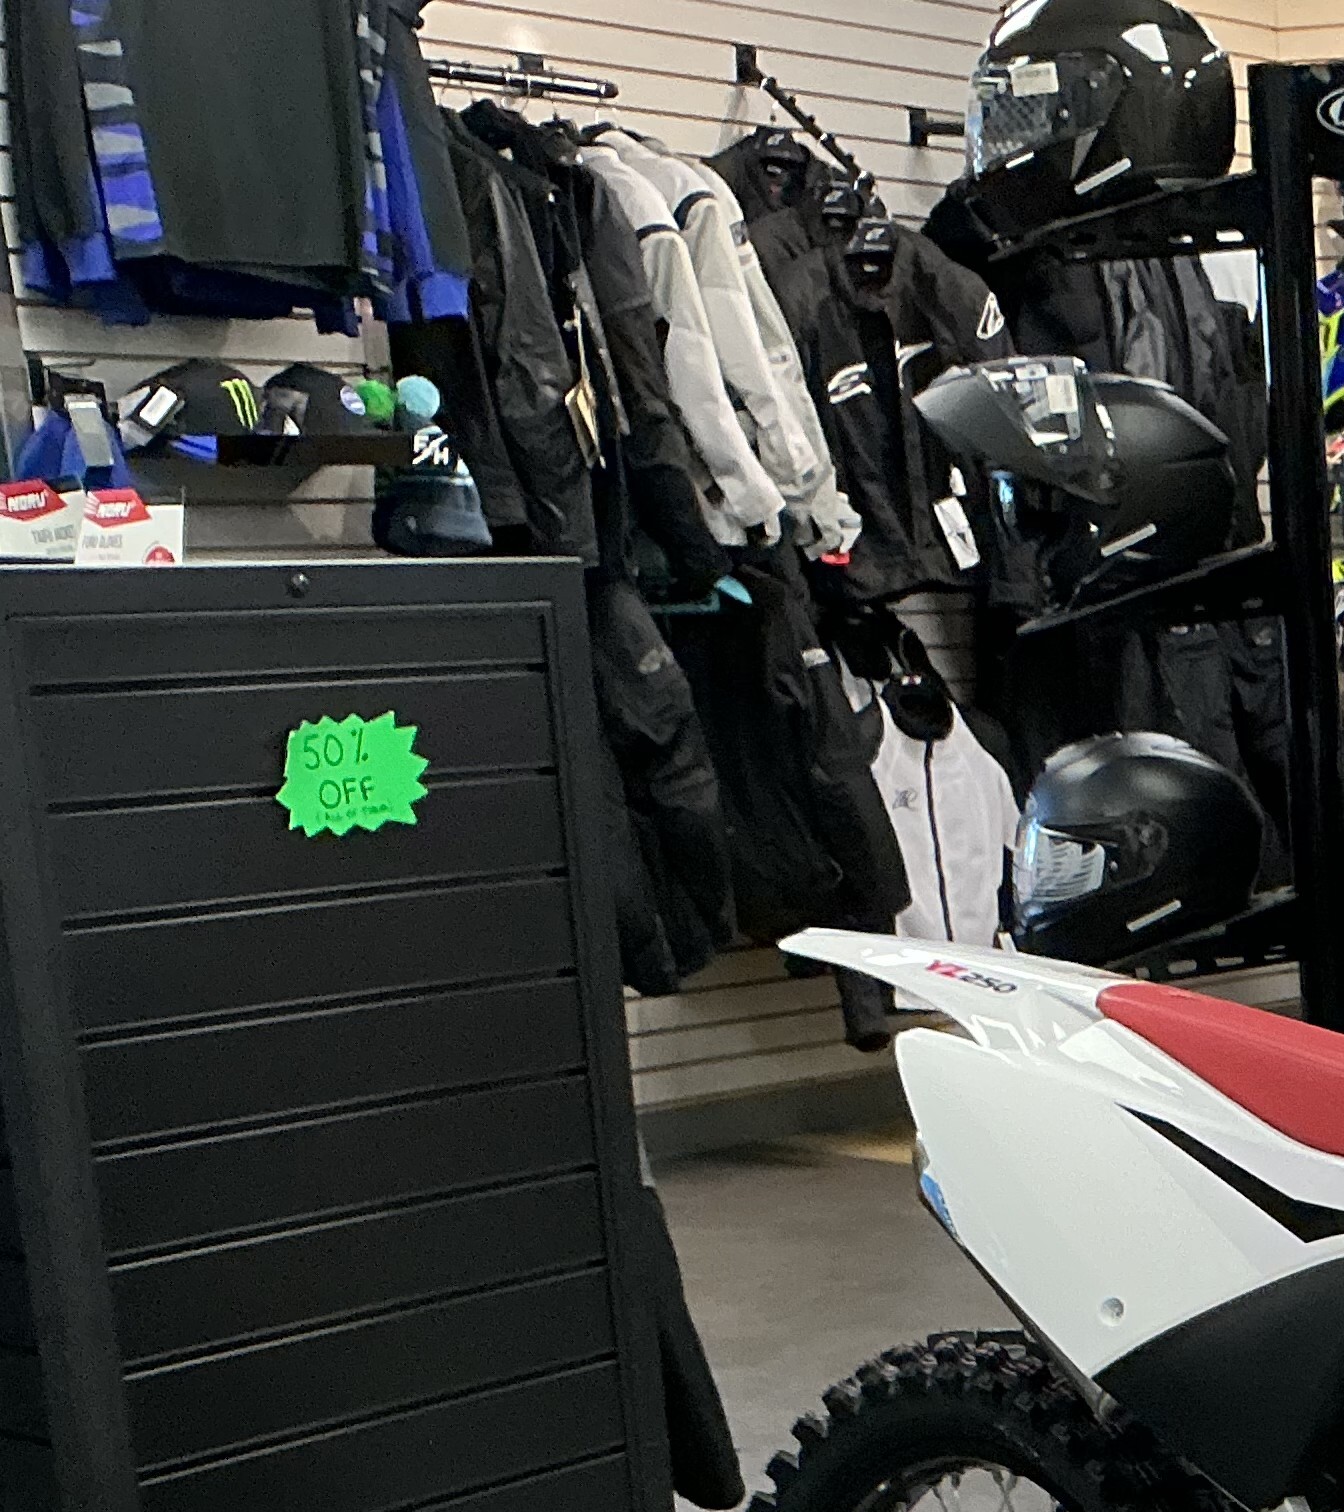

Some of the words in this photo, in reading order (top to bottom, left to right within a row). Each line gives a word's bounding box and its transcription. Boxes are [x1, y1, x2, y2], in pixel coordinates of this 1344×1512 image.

[303, 728, 369, 770] 50%
[319, 776, 375, 809] OFF
[925, 959, 1018, 993] YZ250
